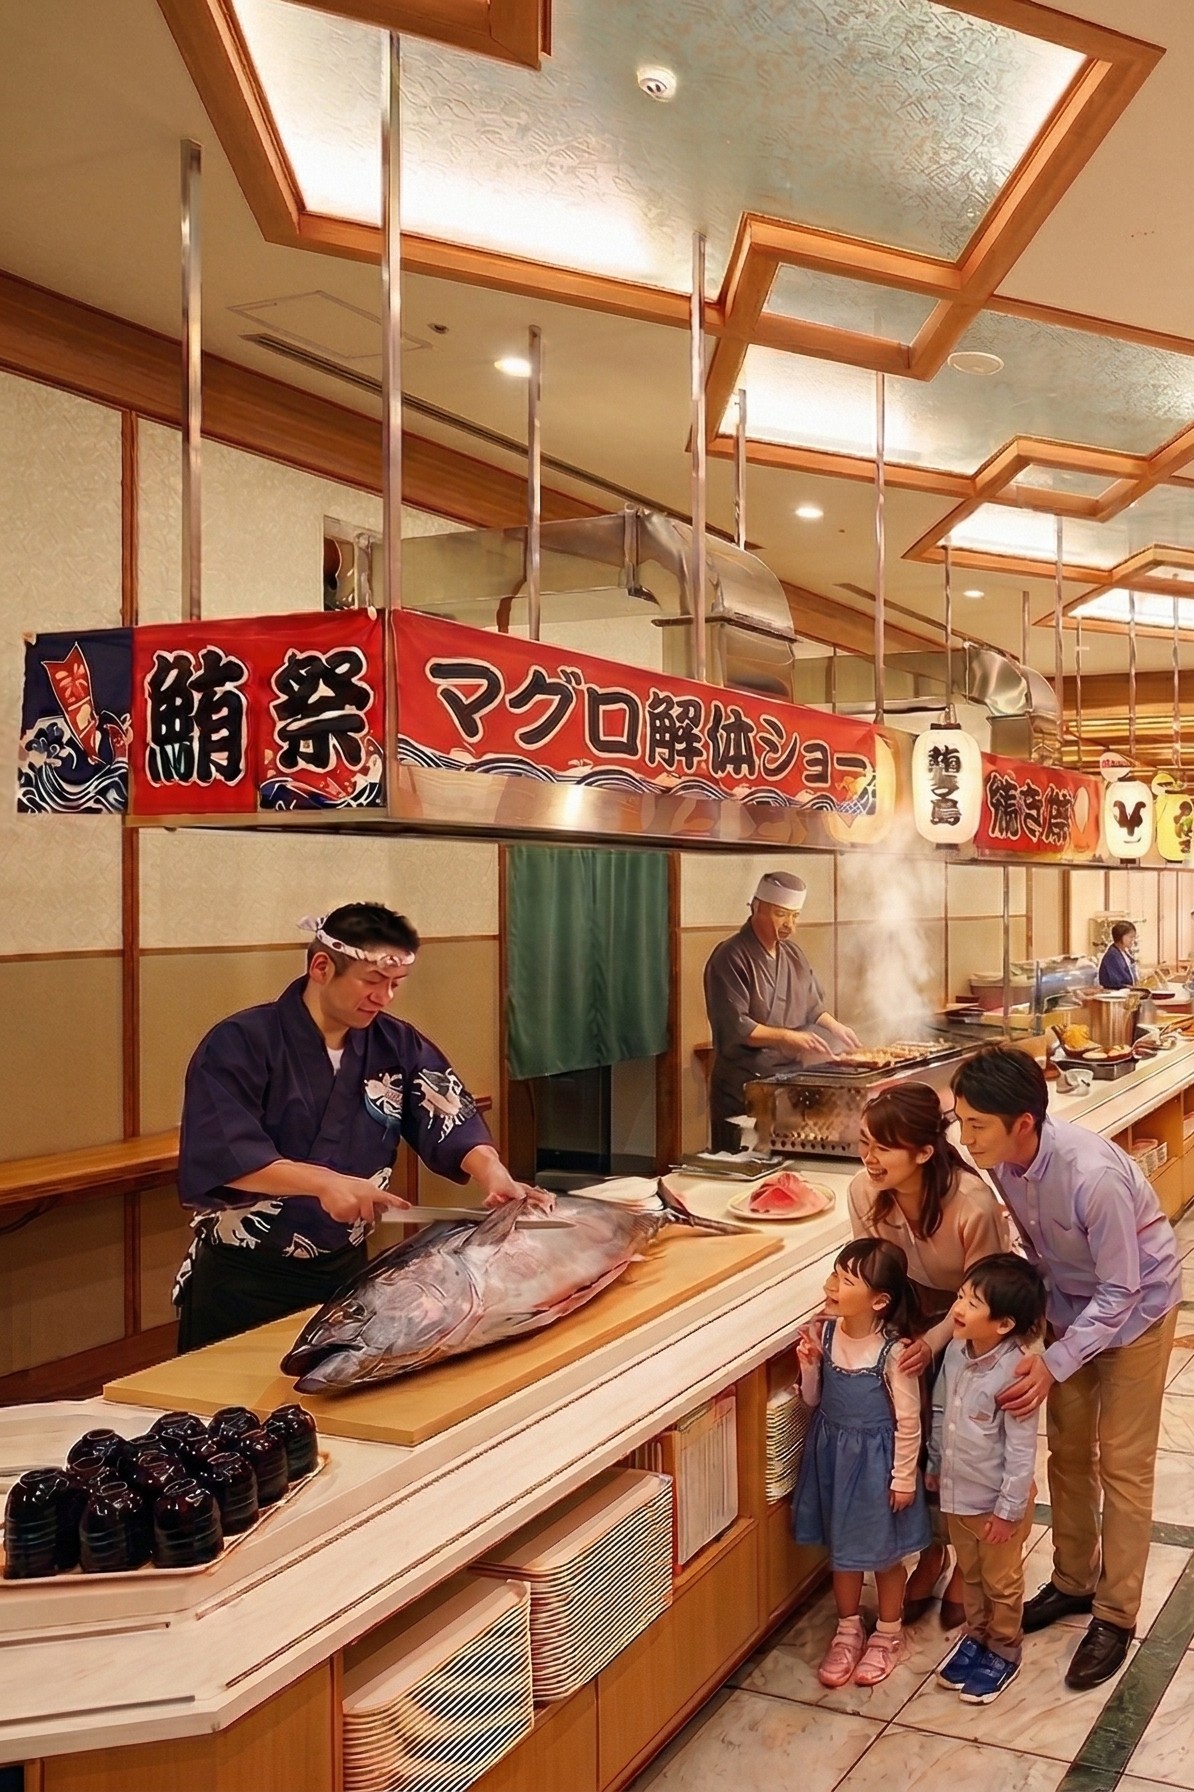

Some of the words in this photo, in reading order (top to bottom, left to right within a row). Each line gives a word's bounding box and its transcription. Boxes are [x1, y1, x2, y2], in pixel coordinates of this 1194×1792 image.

[424, 657, 872, 788] マグロ解体ショー
